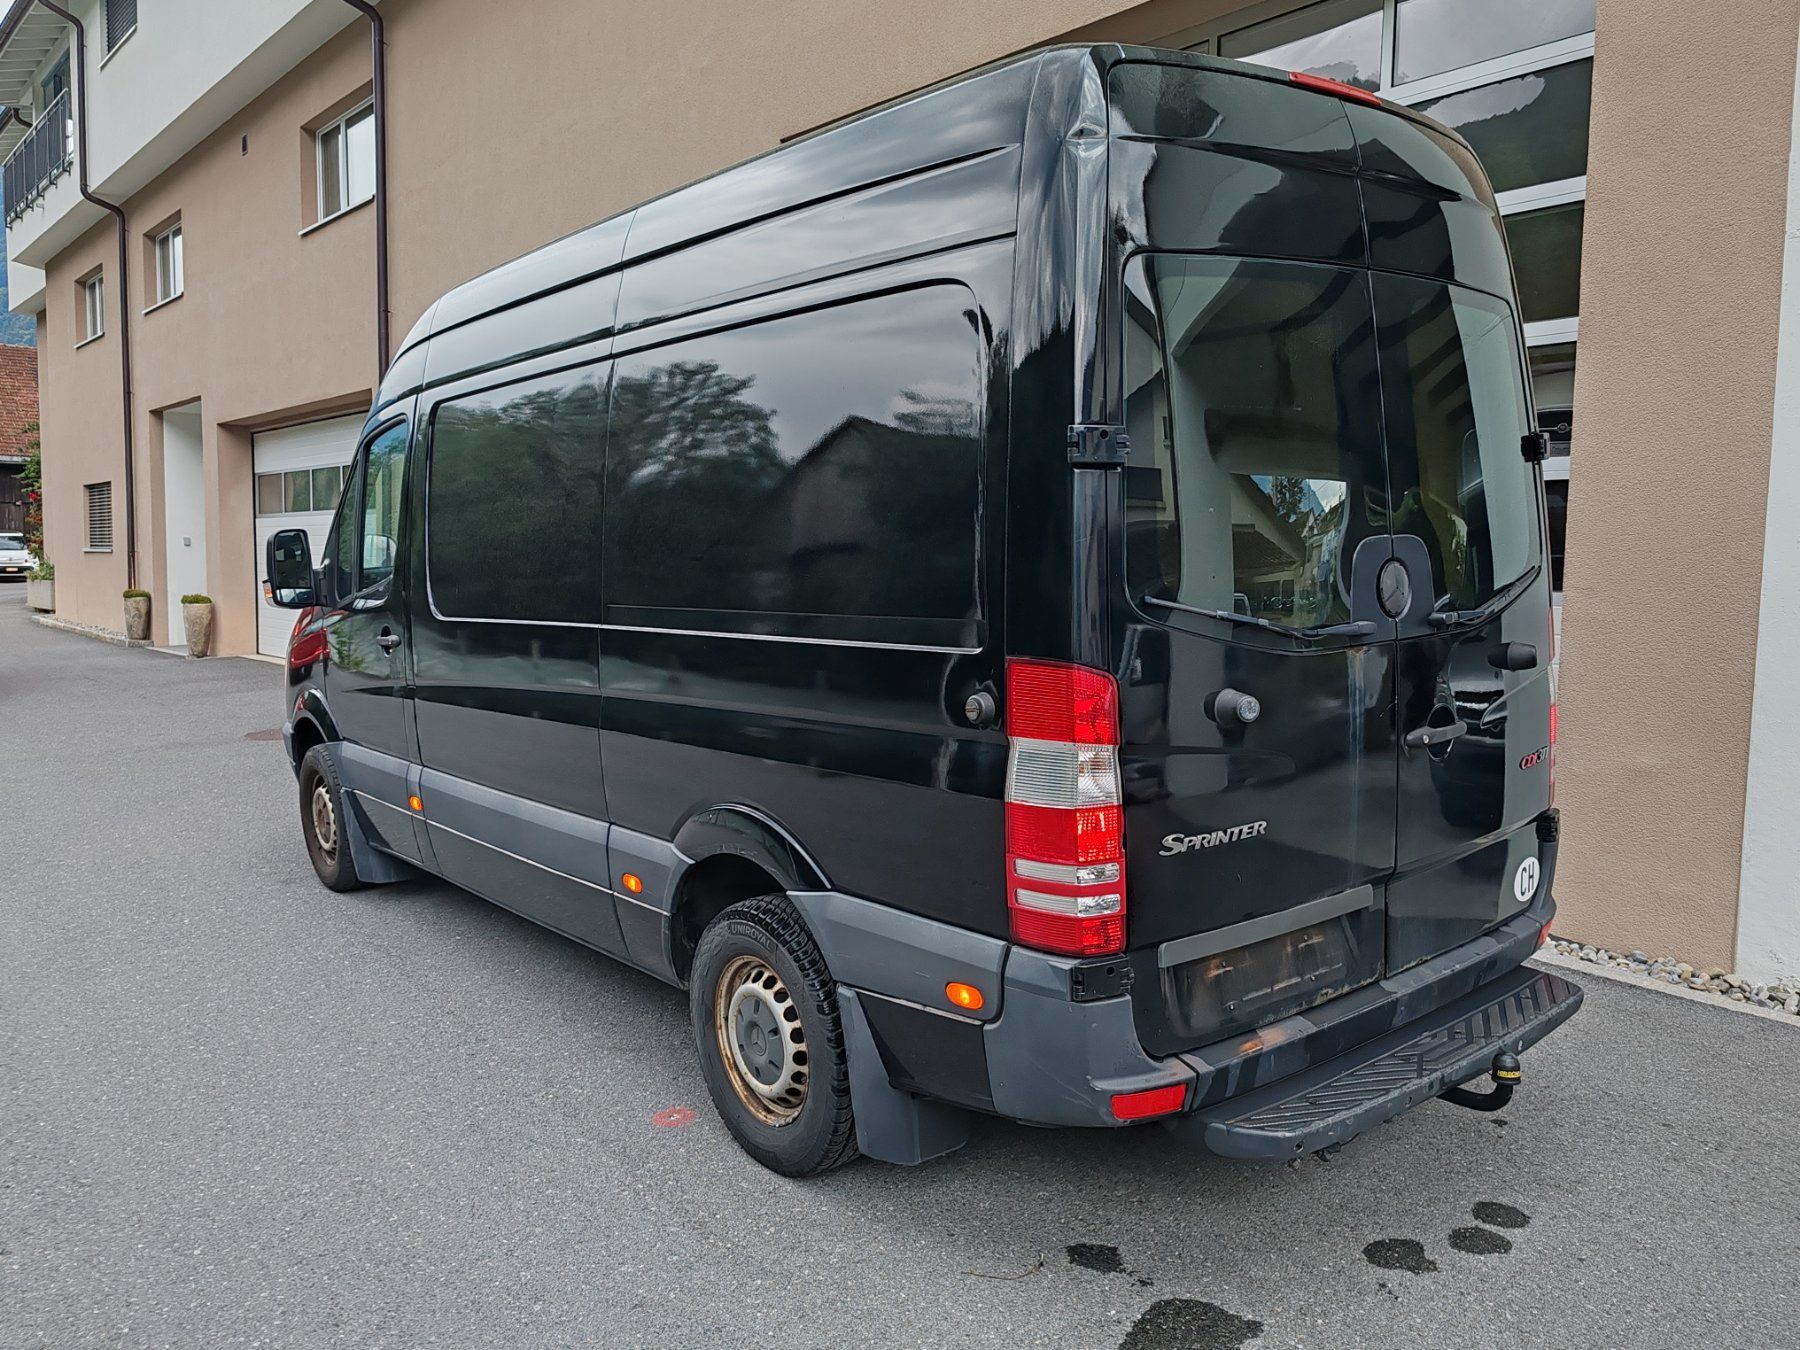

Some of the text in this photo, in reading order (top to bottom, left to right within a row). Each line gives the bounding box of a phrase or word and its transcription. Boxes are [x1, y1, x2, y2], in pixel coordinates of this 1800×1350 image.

[1158, 820, 1268, 857] SPRINTER
[1519, 861, 1535, 896] CH
[731, 923, 772, 950] UNIROYAL
